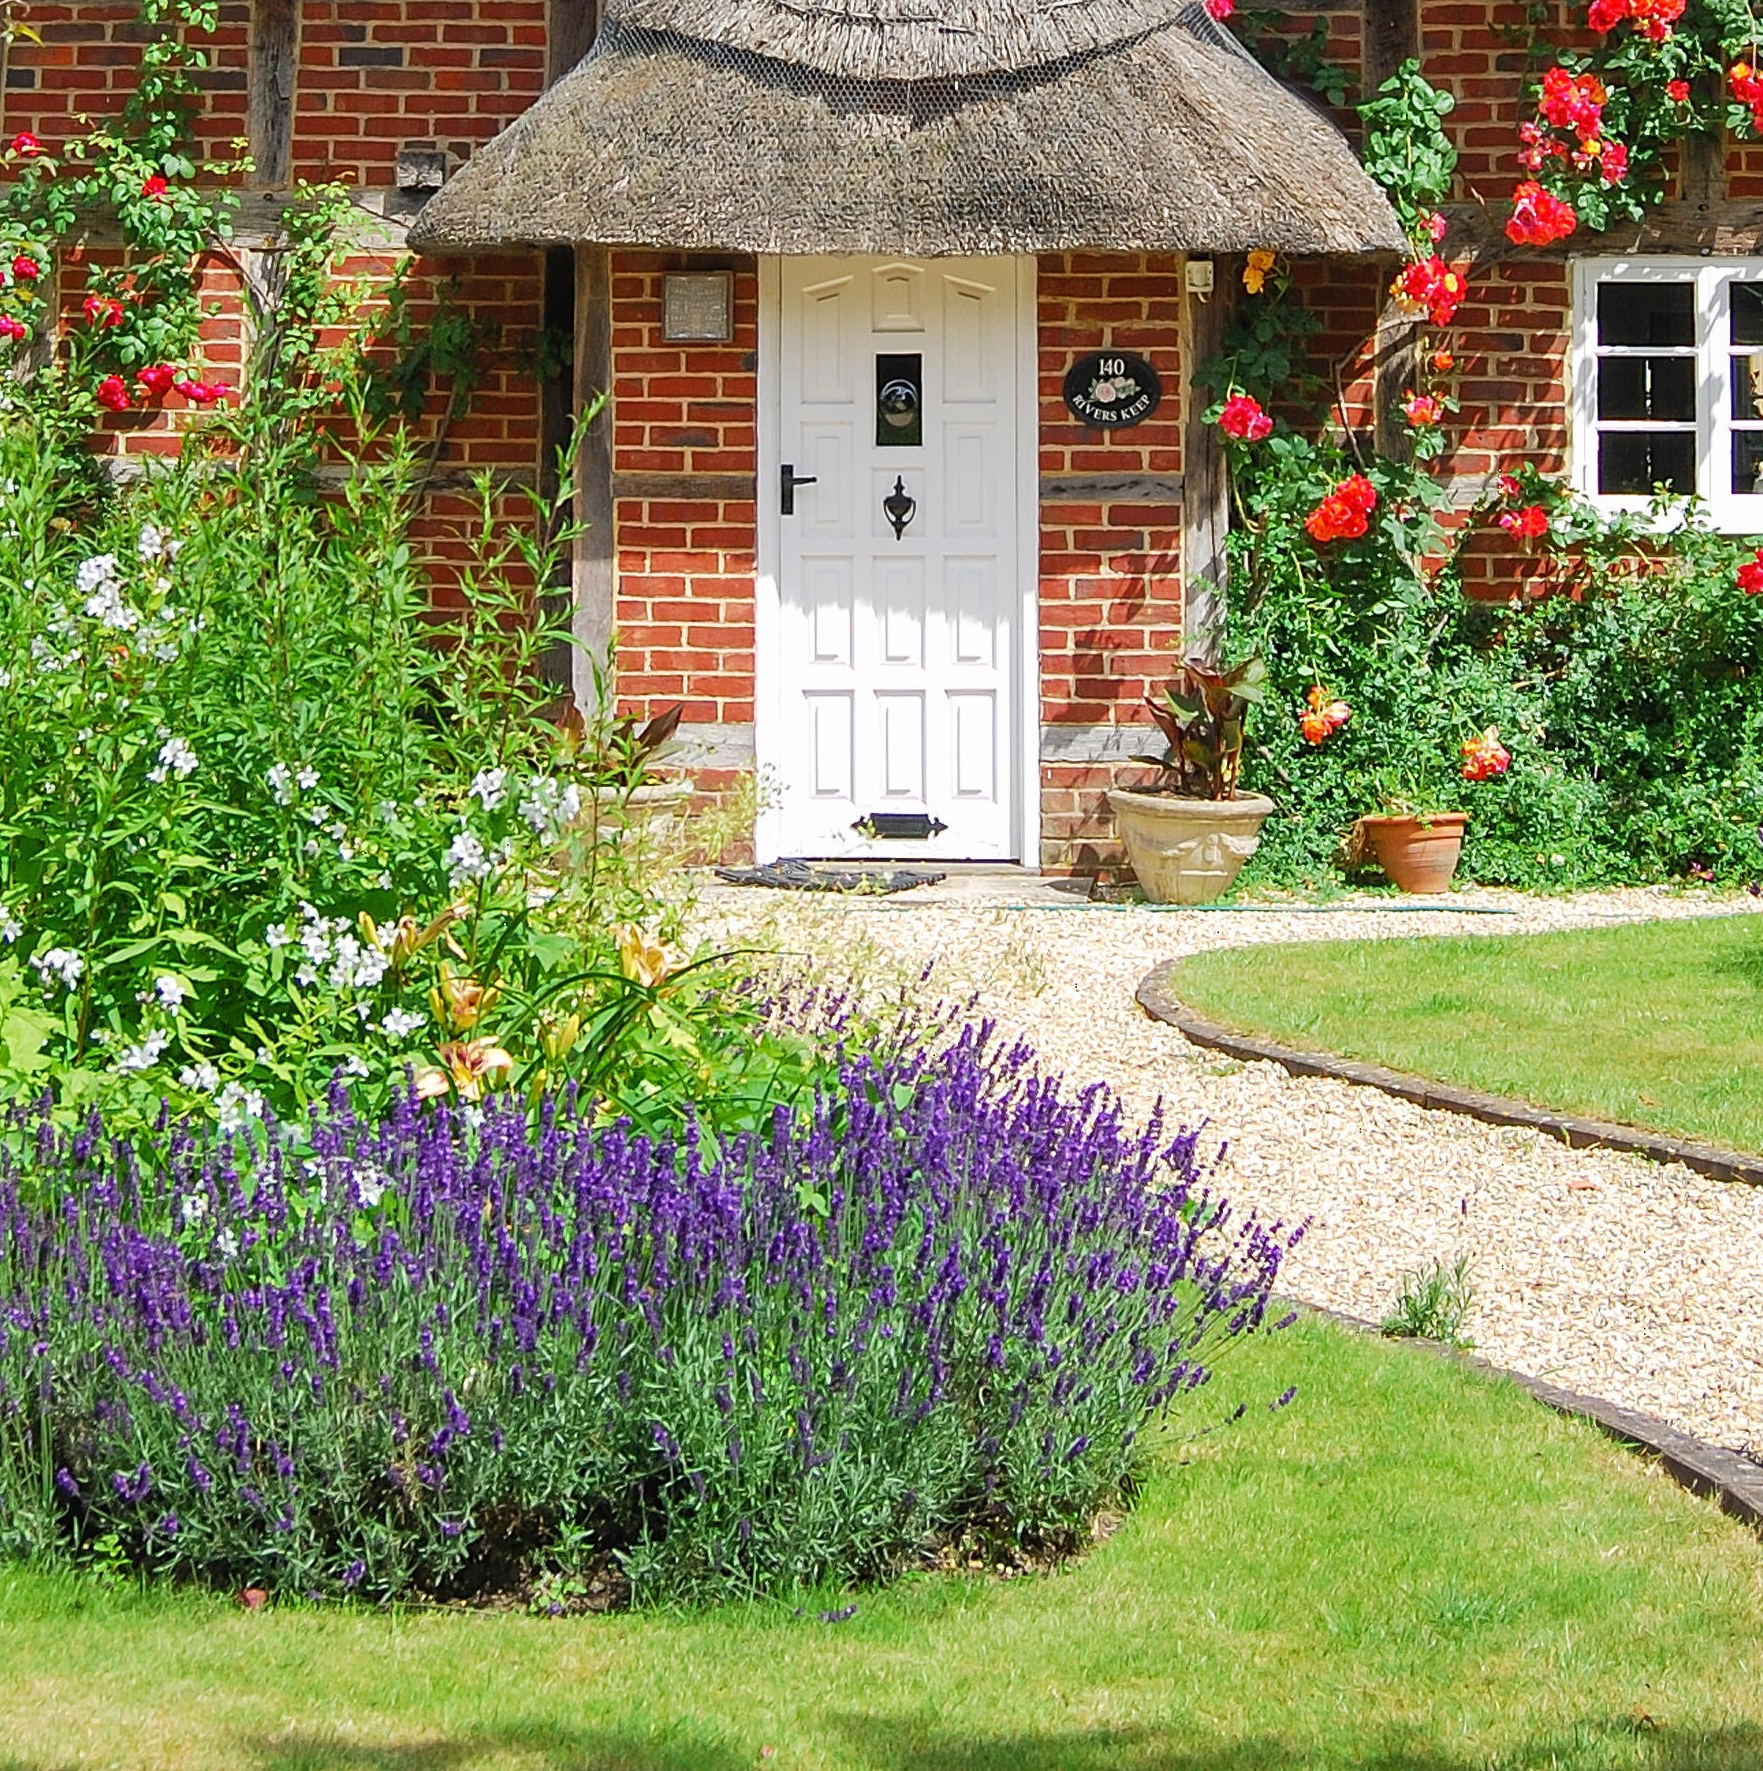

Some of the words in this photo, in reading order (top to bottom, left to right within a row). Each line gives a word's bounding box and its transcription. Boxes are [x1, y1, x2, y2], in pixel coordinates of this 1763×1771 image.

[1099, 359, 1125, 375] 140
[1073, 394, 1117, 421] RIVERS
[1121, 394, 1150, 420] KEEP
